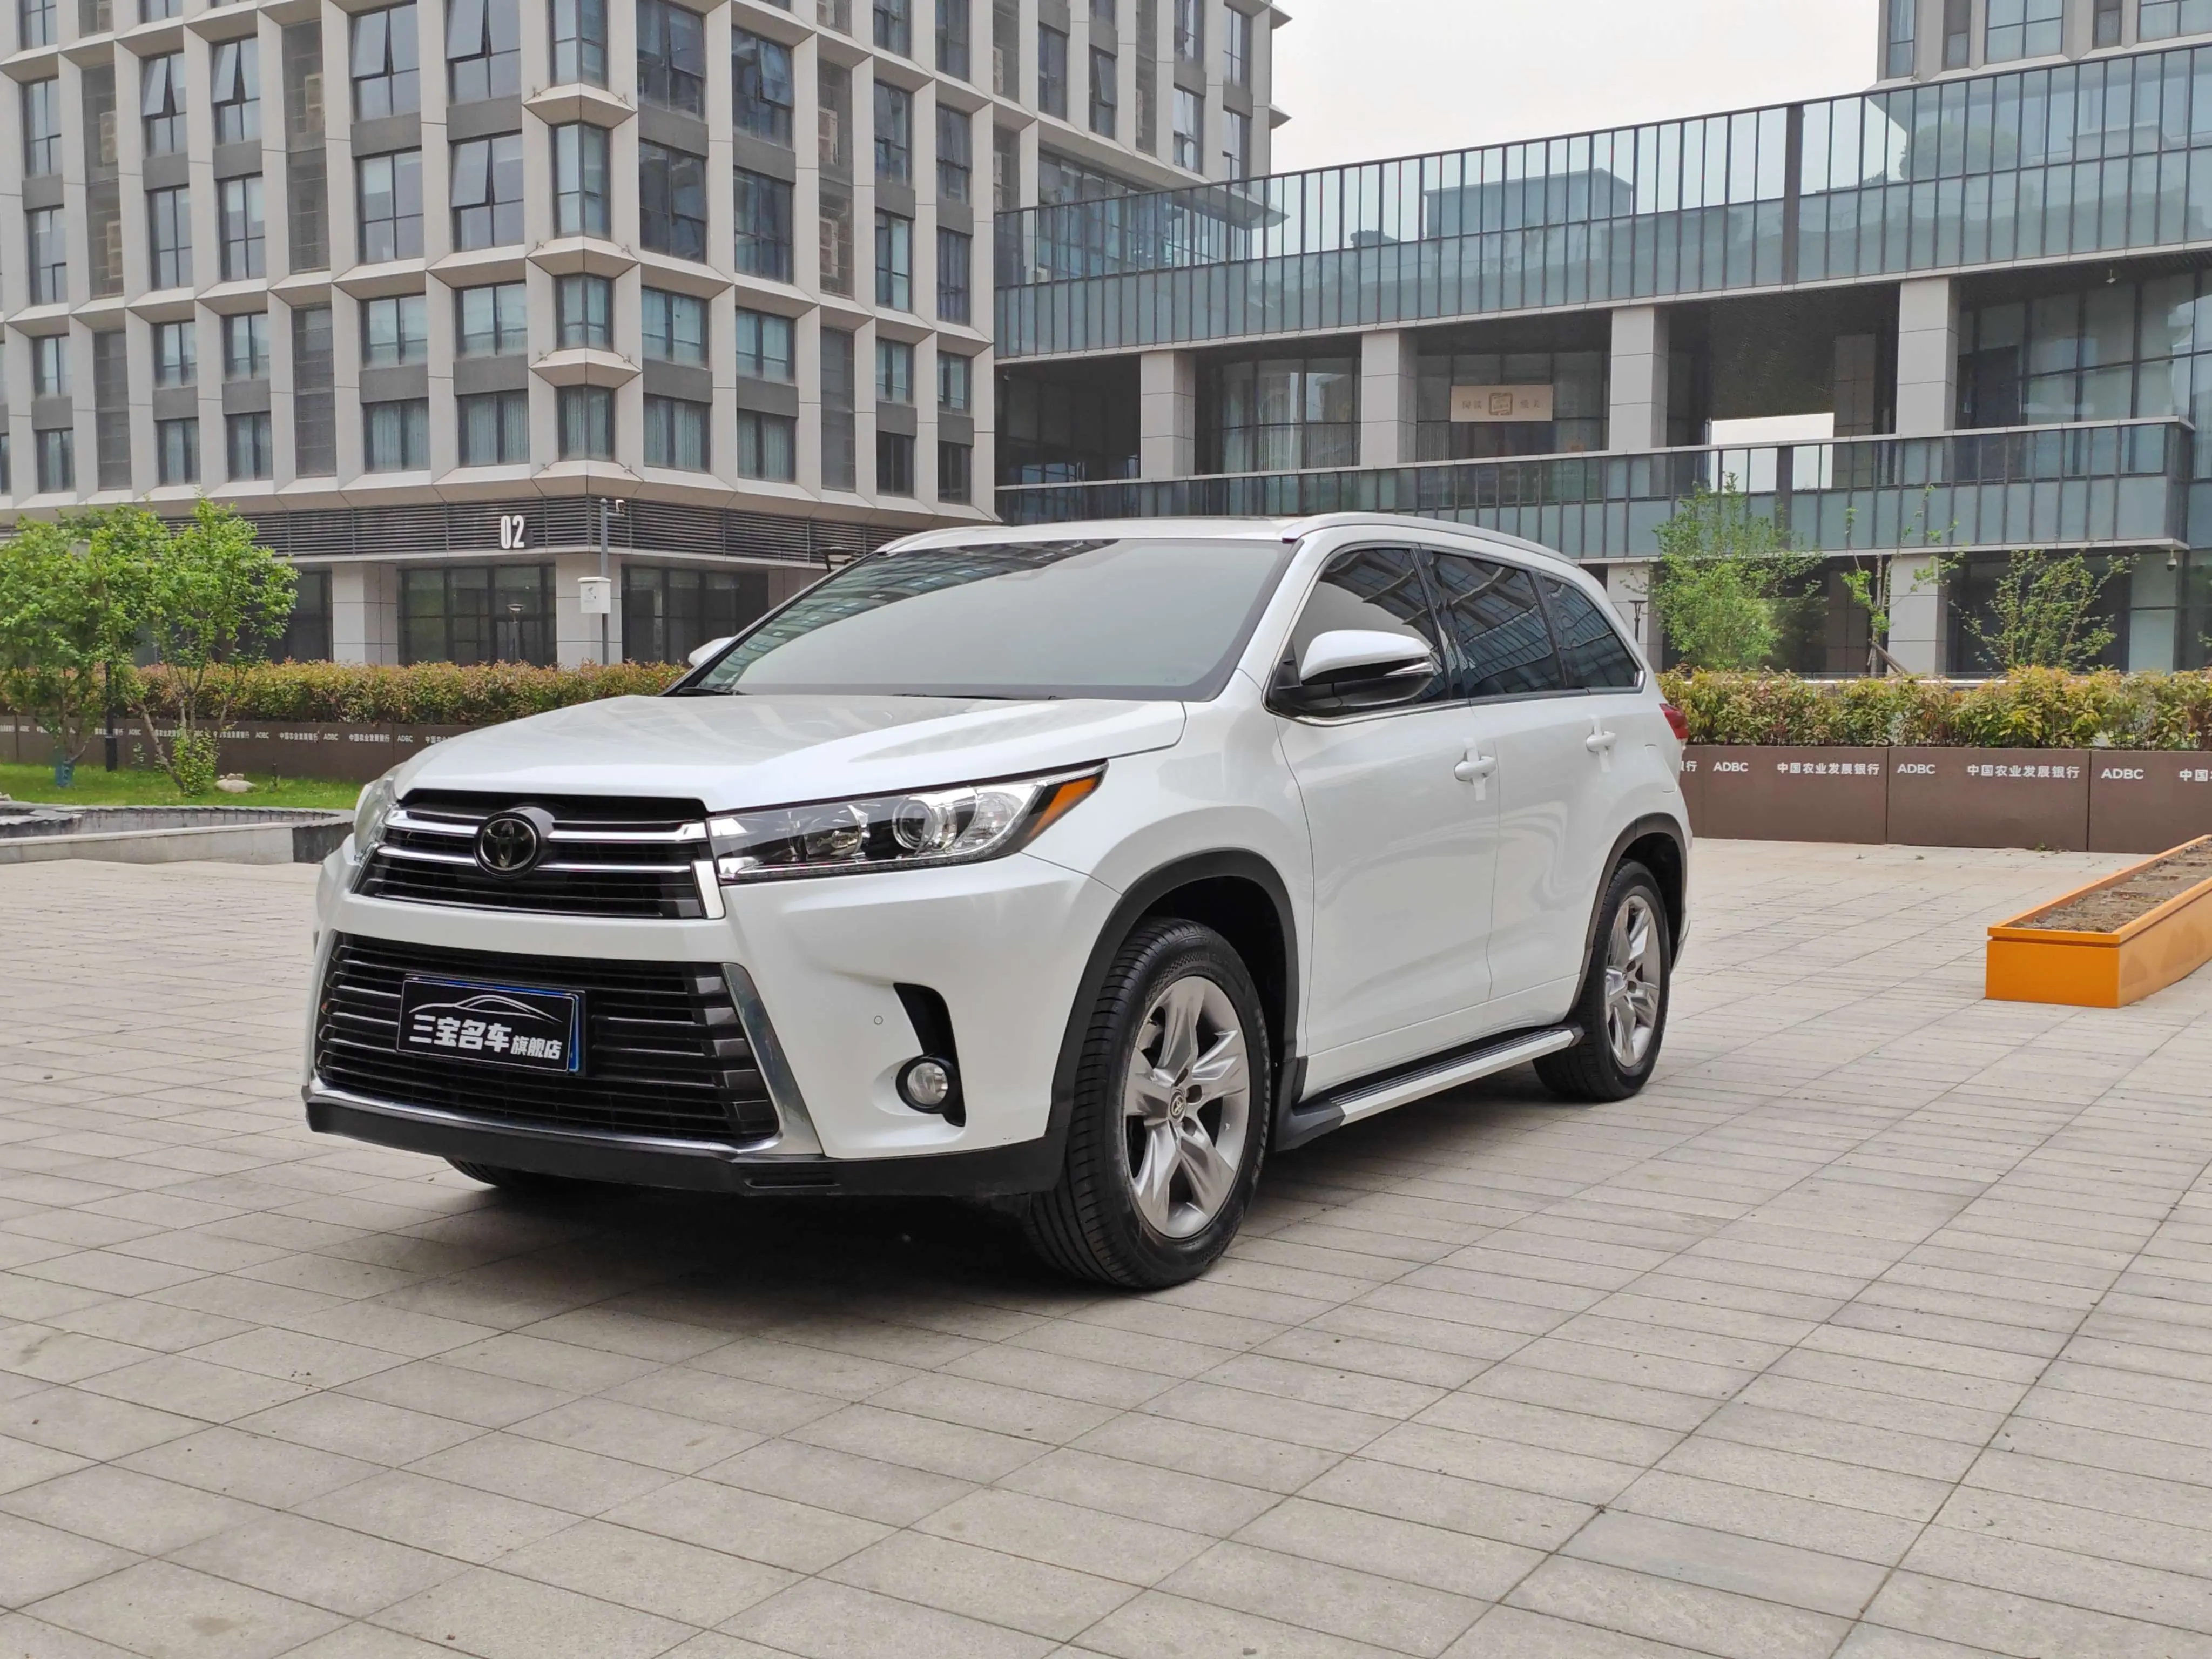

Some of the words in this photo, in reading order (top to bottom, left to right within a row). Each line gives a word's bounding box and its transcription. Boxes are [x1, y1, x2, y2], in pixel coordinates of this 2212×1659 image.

[501, 515, 524, 549] 02
[1713, 761, 1749, 772] ADBC
[1777, 762, 1879, 775] 中国农业发展银行
[1897, 763, 1936, 774] ADBC
[1967, 764, 2080, 779] 中国农业发展银行
[2101, 768, 2144, 779] ADBC
[2179, 768, 2212, 781] 中国
